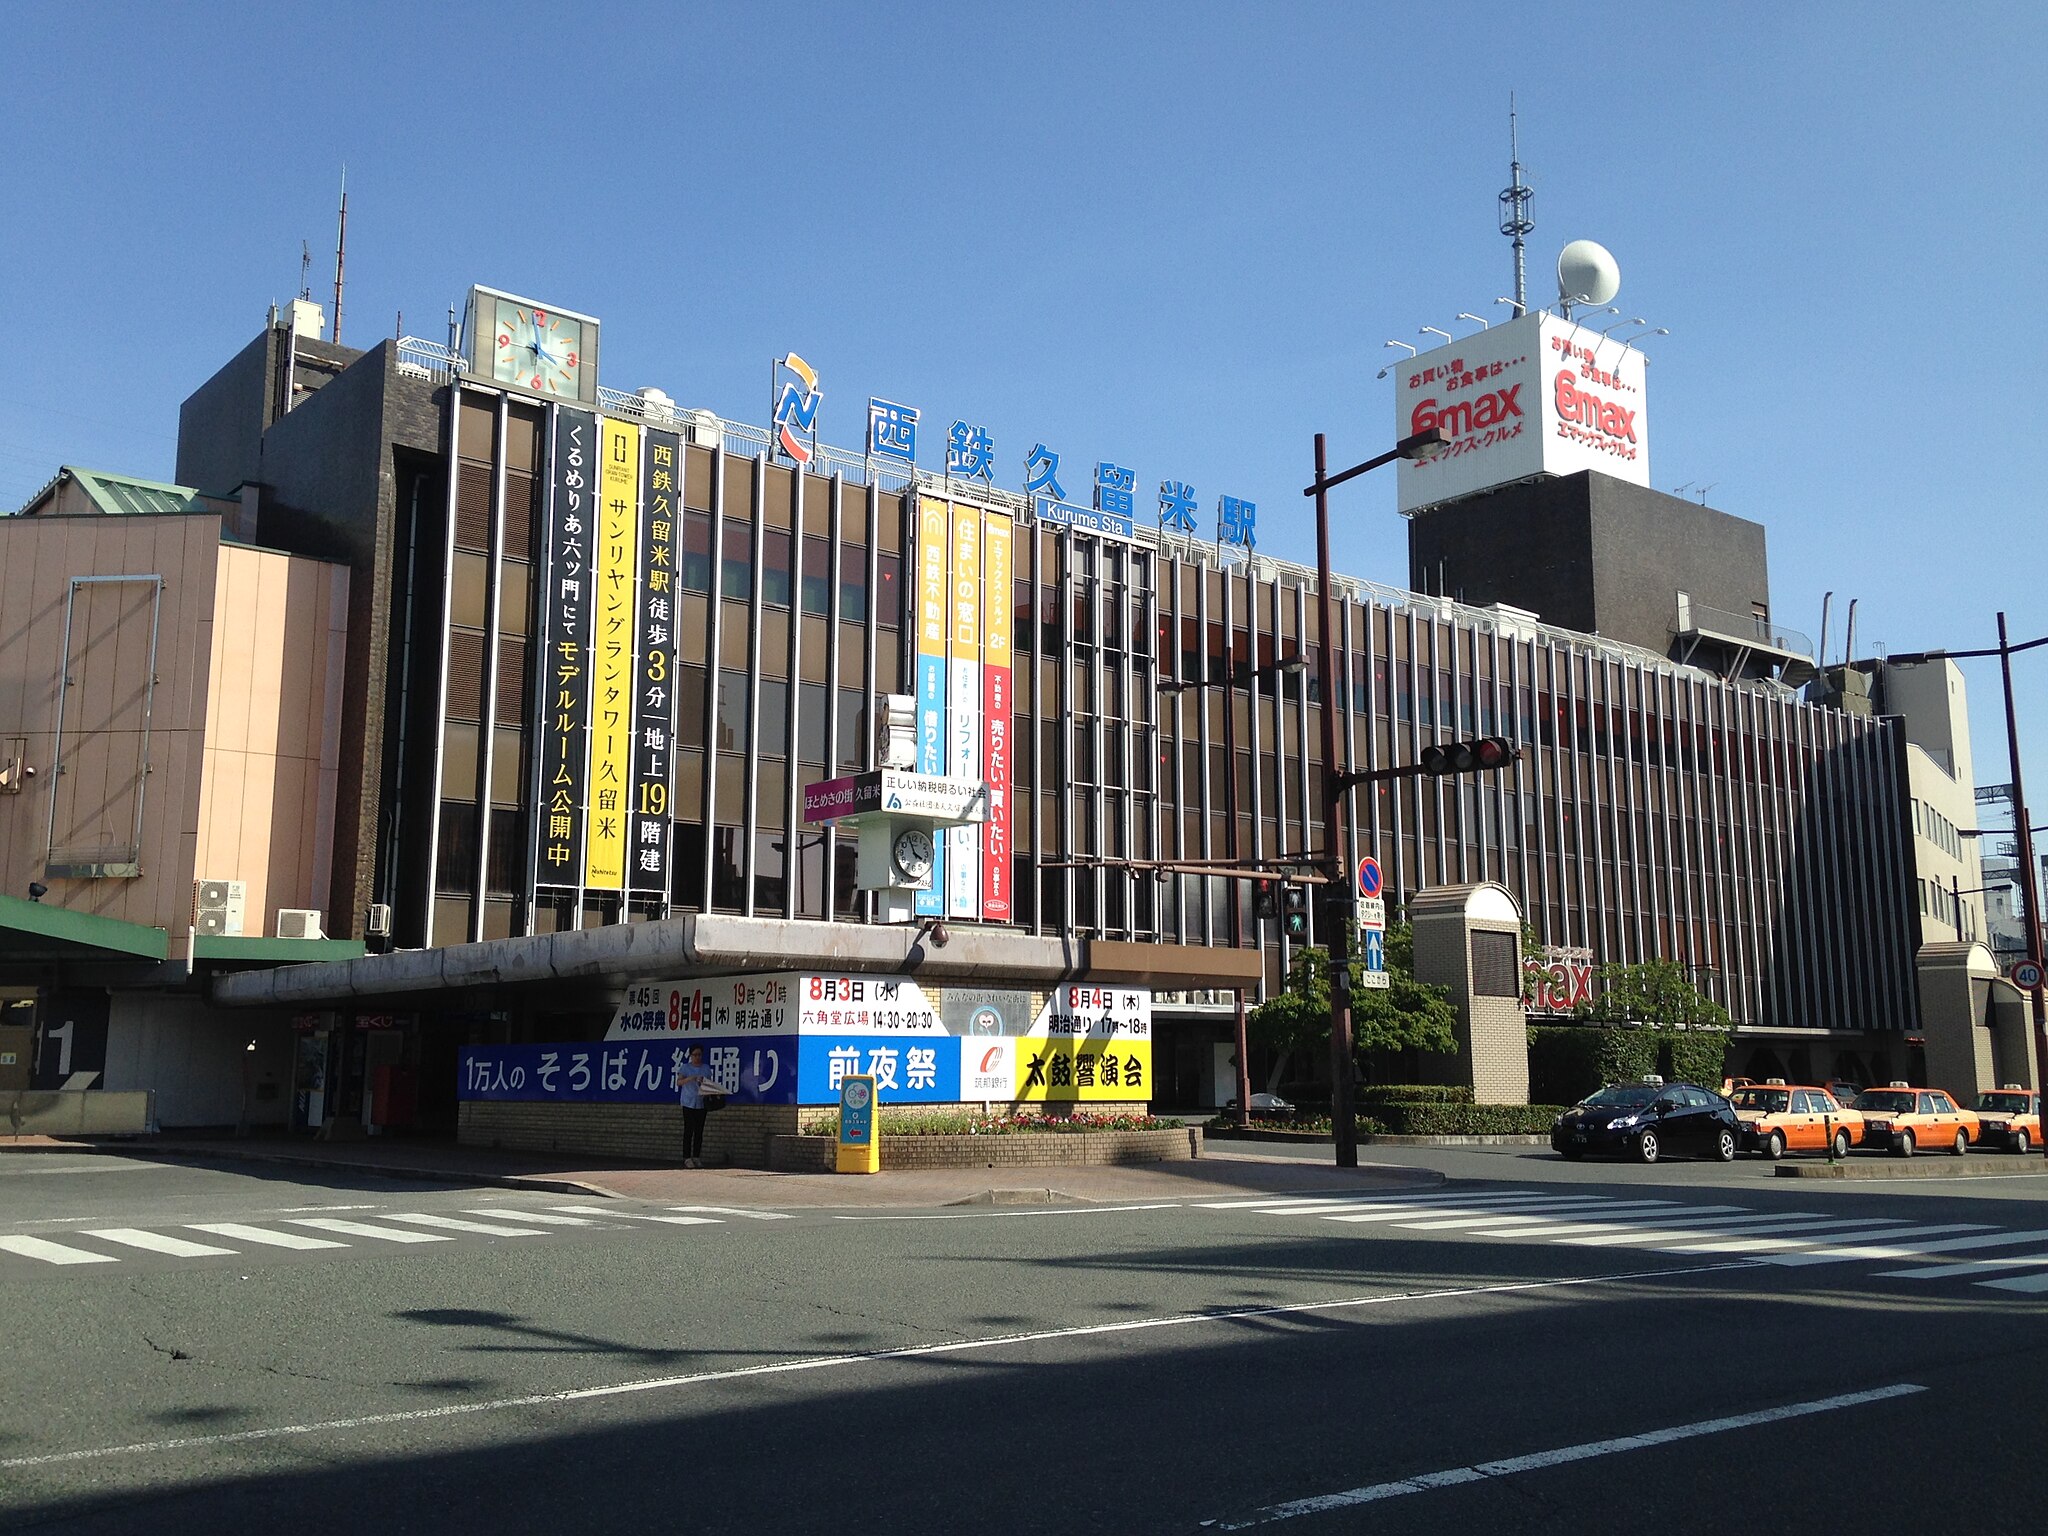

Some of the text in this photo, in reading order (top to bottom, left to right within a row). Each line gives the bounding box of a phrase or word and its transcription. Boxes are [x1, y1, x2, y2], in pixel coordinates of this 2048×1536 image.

[498, 334, 511, 349] 9
[567, 352, 578, 367] 3
[530, 374, 543, 390] 6
[1408, 358, 1464, 389] お買い物
[870, 397, 1258, 552] 西鉄久留米駅
[1047, 501, 1127, 536] Kurume Sta.
[957, 518, 976, 645] 住まいの窓口
[989, 632, 1006, 649] 2F
[804, 783, 881, 810] ほとめきの街 久留米
[886, 776, 987, 799] 正しい納税明るい社会
[2019, 968, 2037, 982] 40
[628, 987, 661, 1008] 第45回
[809, 976, 864, 1002] 8月3日
[1068, 987, 1113, 1010] 8月4日
[620, 1010, 666, 1033] 水の祭典
[735, 1008, 785, 1030] 明治通り
[802, 1009, 869, 1026] 六角堂広場
[1048, 1014, 1092, 1034] 明治通り
[827, 1045, 937, 1091] 前夜祭
